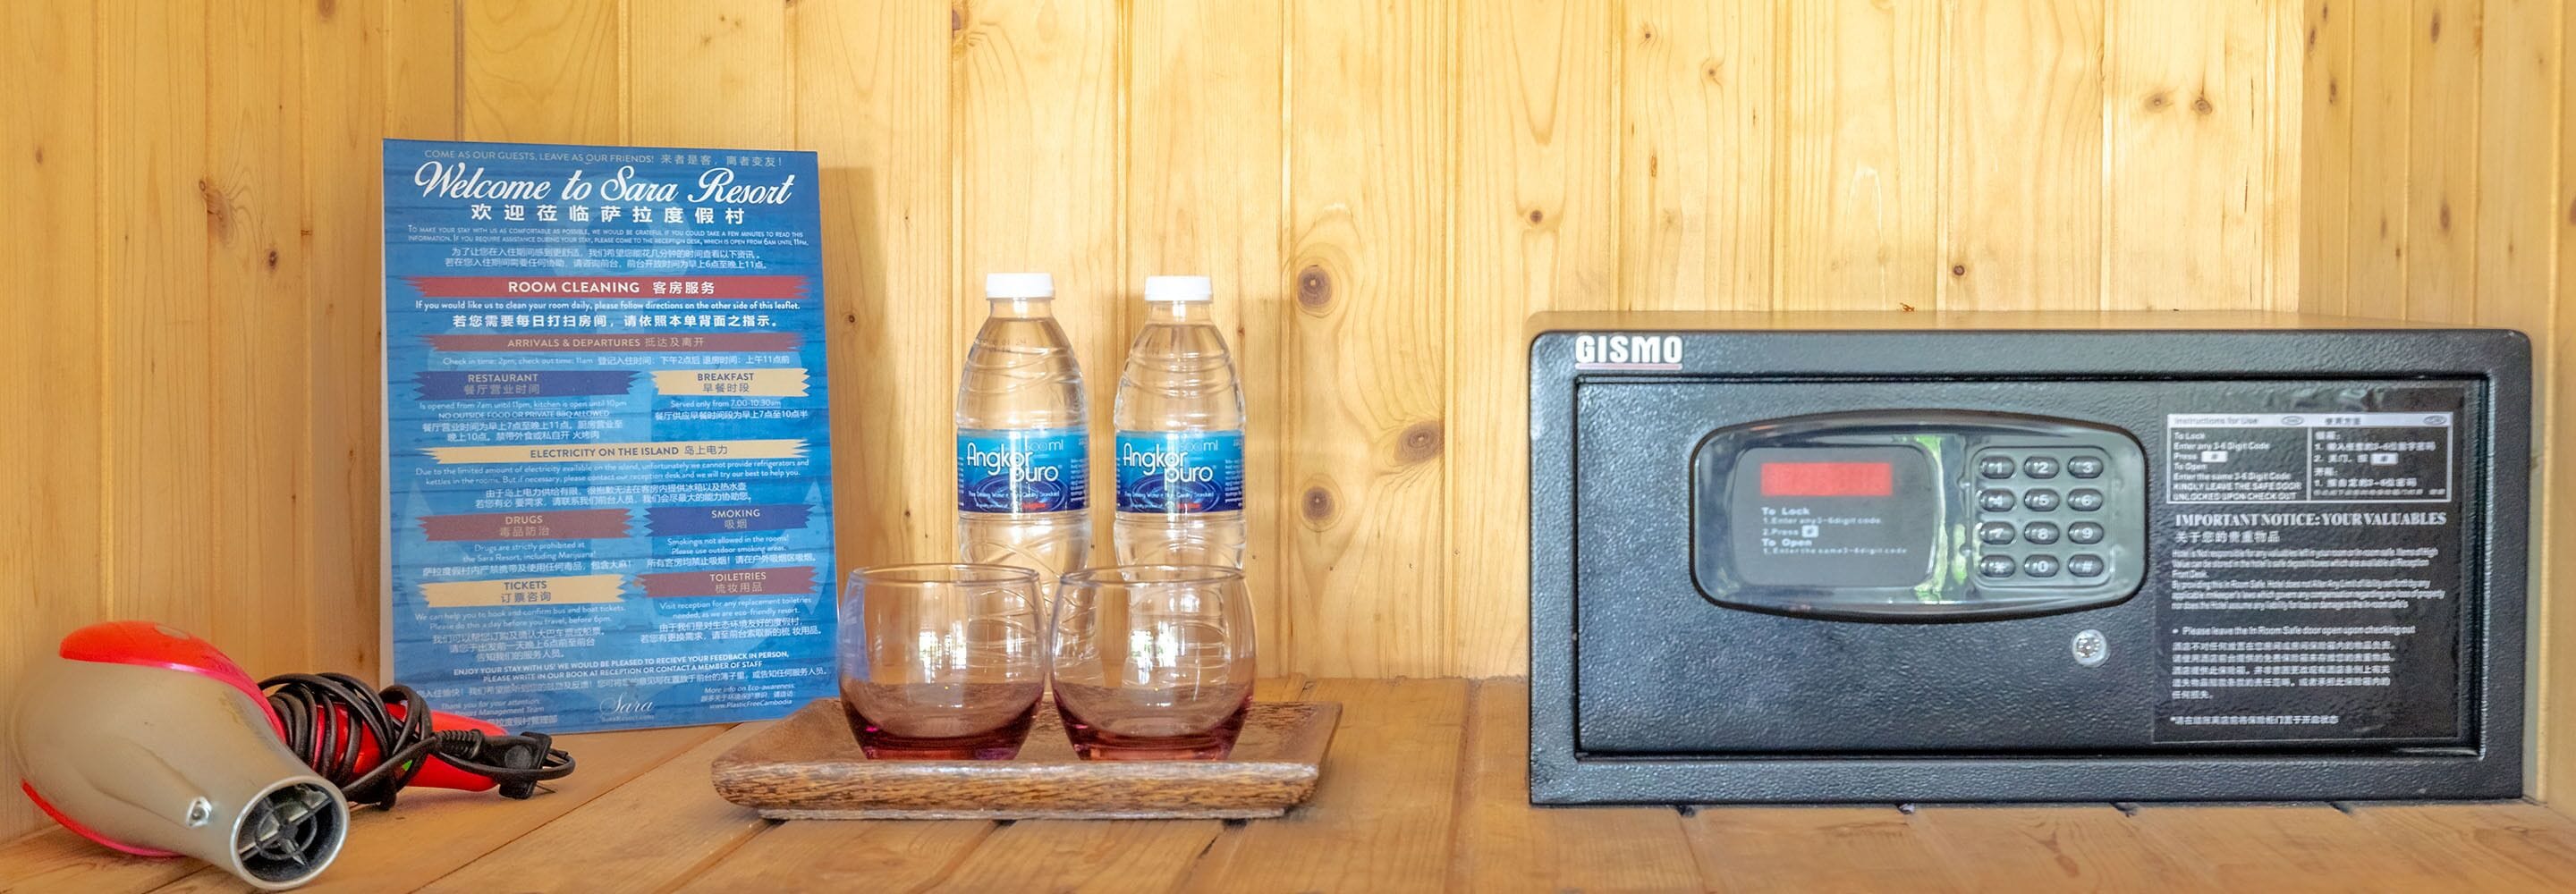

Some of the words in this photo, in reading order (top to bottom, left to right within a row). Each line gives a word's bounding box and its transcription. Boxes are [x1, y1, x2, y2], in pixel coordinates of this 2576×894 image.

[425, 150, 454, 158] COME
[473, 151, 496, 159] OUR
[498, 152, 537, 161] GUESTS,
[572, 154, 584, 162] AS
[586, 154, 607, 162] OUR
[609, 155, 653, 163] FRIENDS!
[415, 161, 551, 199] Welcome
[561, 170, 592, 200] to
[601, 166, 679, 201] Sara
[688, 168, 795, 204] Resort
[470, 203, 745, 225] 欢迎莅临萨拉度假村
[508, 282, 556, 293] ROOM
[562, 282, 640, 293] CLEANING
[653, 282, 715, 294] 客房服务
[416, 300, 423, 308] If
[425, 302, 439, 311] you
[442, 300, 465, 309] would
[468, 300, 482, 309] like
[505, 300, 527, 309] clean
[530, 303, 546, 311] your
[572, 300, 592, 311] daily,
[594, 300, 618, 311] please
[621, 301, 643, 309] follow
[646, 301, 683, 309] directions
[697, 301, 708, 309] the
[711, 301, 731, 309] other
[733, 301, 748, 309] side
[750, 301, 758, 309] of
[759, 301, 773, 309] this
[775, 301, 800, 309] leaflet.
[508, 339, 560, 347] ARRIVALS
[563, 339, 570, 347] &
[572, 339, 640, 348] DEPARTURES
[1575, 334, 1682, 363] GISMO
[468, 374, 538, 383] RESTAURANT
[698, 373, 753, 381] BREAKFAST
[703, 383, 750, 392] 早餐时段
[530, 449, 596, 459] ELECTRICITY
[598, 447, 615, 457] ON
[619, 448, 638, 456] THE
[641, 447, 679, 455] ISLAND
[684, 445, 727, 455] 岛上电力
[967, 443, 1033, 476] Angkor
[1123, 443, 1188, 476] Angkor
[1995, 462, 2004, 473] 1
[2038, 462, 2048, 473] 2
[2082, 462, 2093, 473] 3
[1010, 466, 1058, 491] puro
[1165, 467, 1213, 491] puro
[1992, 494, 2004, 506] 4
[2038, 494, 2049, 506] 5
[2080, 494, 2091, 506] 6
[711, 509, 760, 518] SMOKING
[1761, 507, 1775, 515] To
[1782, 507, 1809, 515] Lock
[505, 515, 543, 524] DRUGS
[724, 519, 747, 529] 吸烟
[2175, 514, 2259, 527] IMPORTANT
[2260, 513, 2320, 527] NOTICE:
[2321, 514, 2362, 526] YOUR
[2363, 512, 2446, 525] VALUABLES
[1993, 528, 2003, 539] 7
[2038, 527, 2048, 539] 8
[2081, 527, 2092, 539] 9
[1761, 538, 1775, 546] To
[1782, 538, 1812, 547] Open
[2038, 560, 2048, 571] 0
[710, 572, 766, 582] TOILETRIES
[504, 581, 547, 590] TICKETS
[453, 668, 478, 676] ENJOY
[480, 667, 502, 675] YOUR
[504, 665, 521, 673] STAY
[522, 664, 542, 672] WITH
[544, 663, 555, 671] US!
[611, 658, 643, 668] PLEASED
[656, 656, 686, 664] RECIEVE
[710, 653, 747, 662] FEEDBACK
[758, 651, 789, 659] PERSON,
[483, 675, 510, 683] PLEASE
[566, 670, 588, 679] BOOK
[602, 666, 642, 677] RECEPTION
[656, 664, 691, 673] CONTACT
[698, 662, 728, 670] MEMBER
[599, 691, 655, 713] Sara
